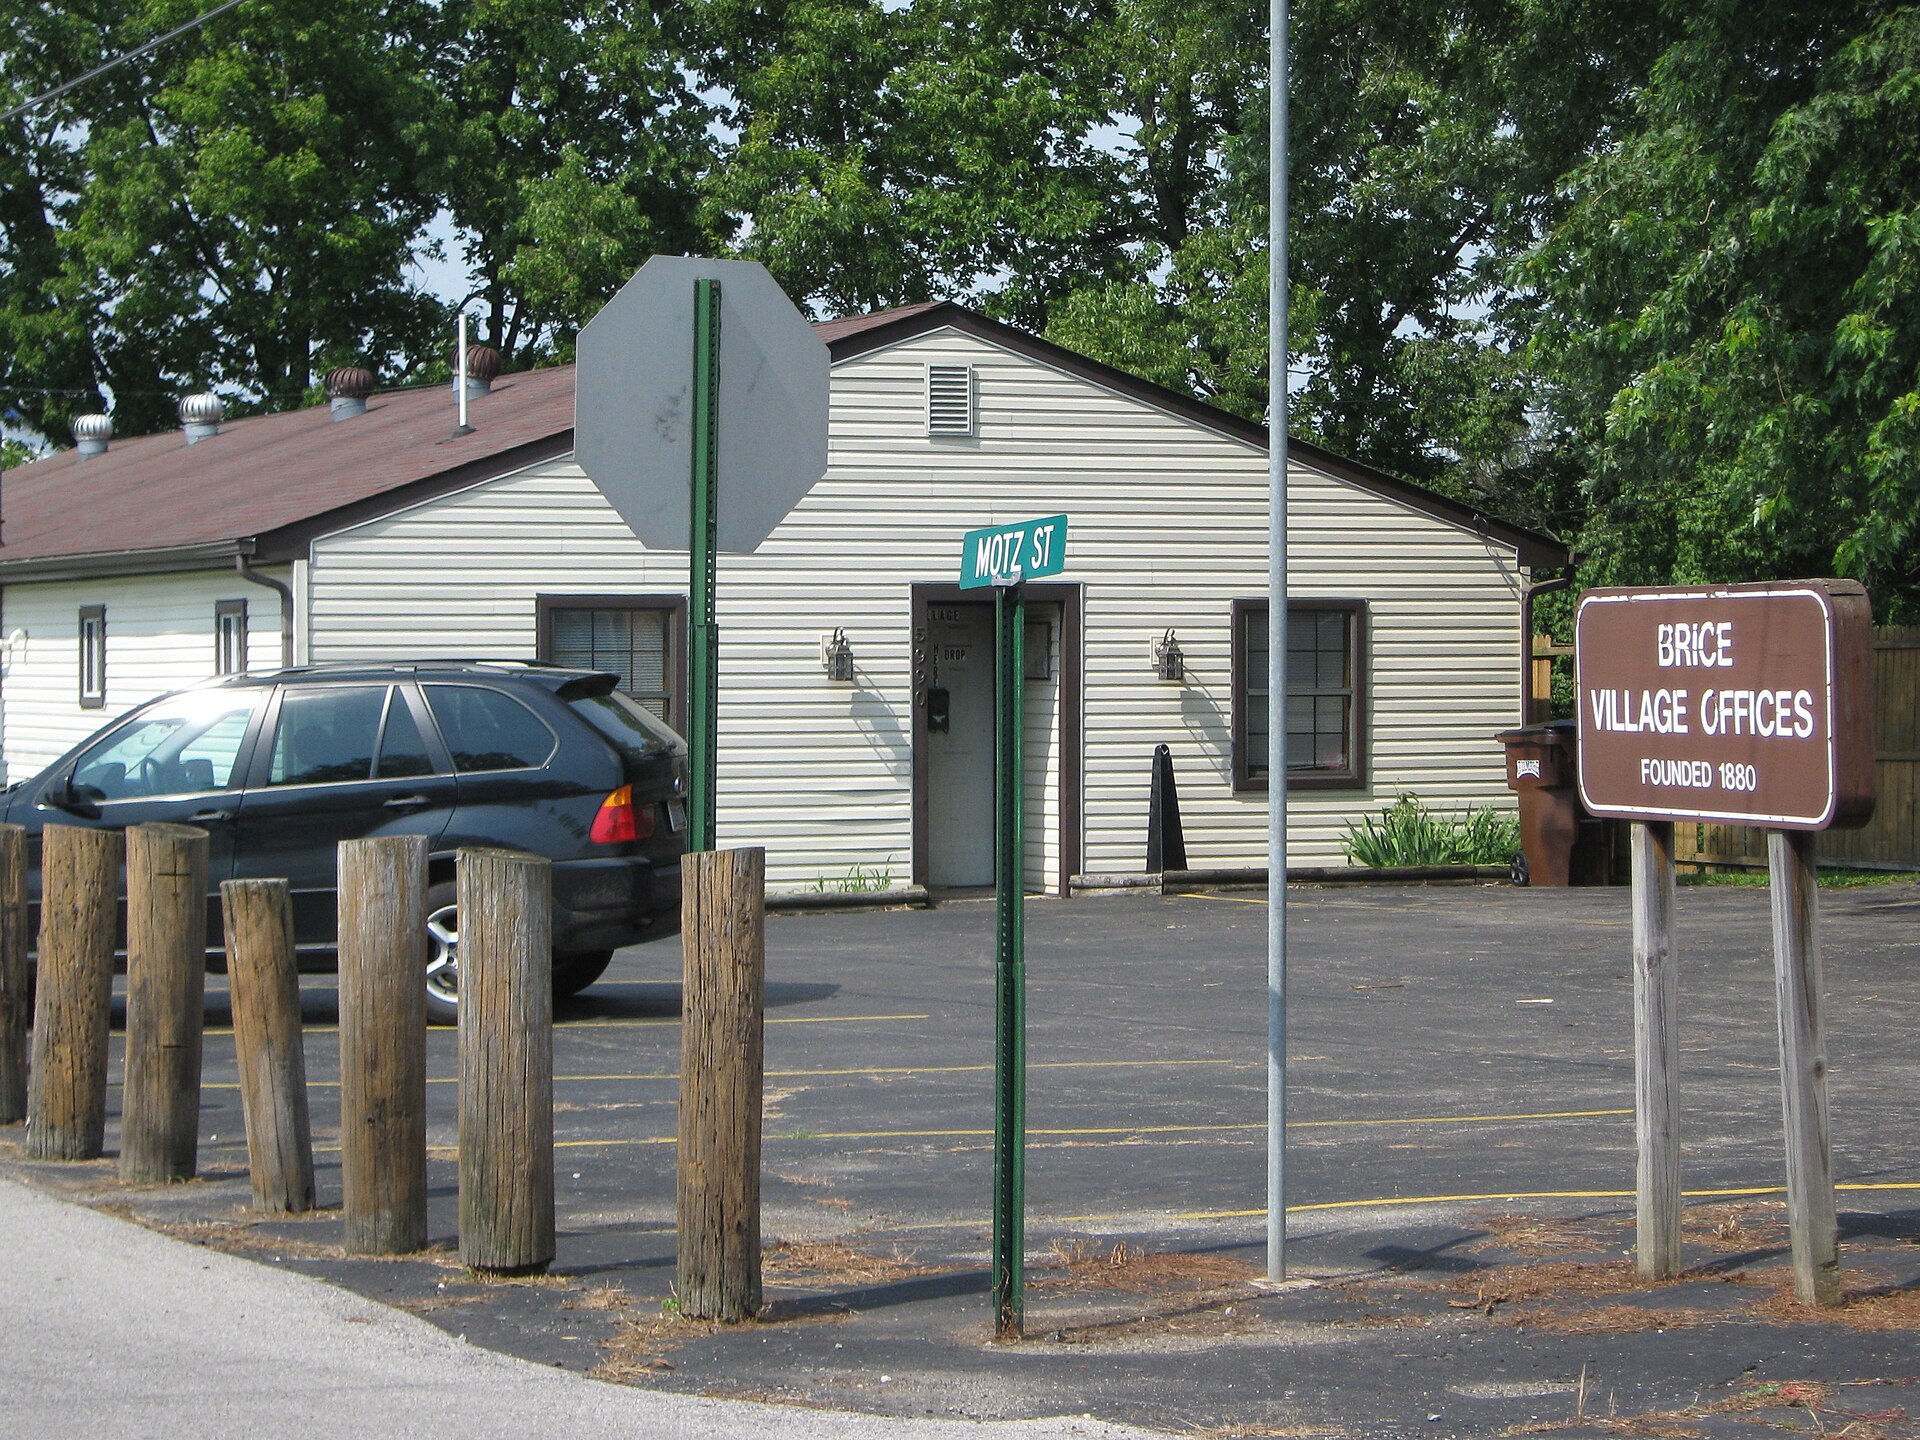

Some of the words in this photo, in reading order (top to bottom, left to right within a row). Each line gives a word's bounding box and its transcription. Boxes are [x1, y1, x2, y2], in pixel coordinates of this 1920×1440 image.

[975, 530, 1025, 578] MOTZ
[1031, 525, 1055, 570] ST
[927, 610, 960, 622] LAGE
[944, 649, 966, 661] DROP
[1657, 621, 1733, 668] BRICE
[1590, 688, 1688, 733] VILLAGE
[1700, 689, 1814, 738] OFFICES
[1640, 758, 1712, 788] FOUNDED
[1718, 762, 1756, 791] 1880
